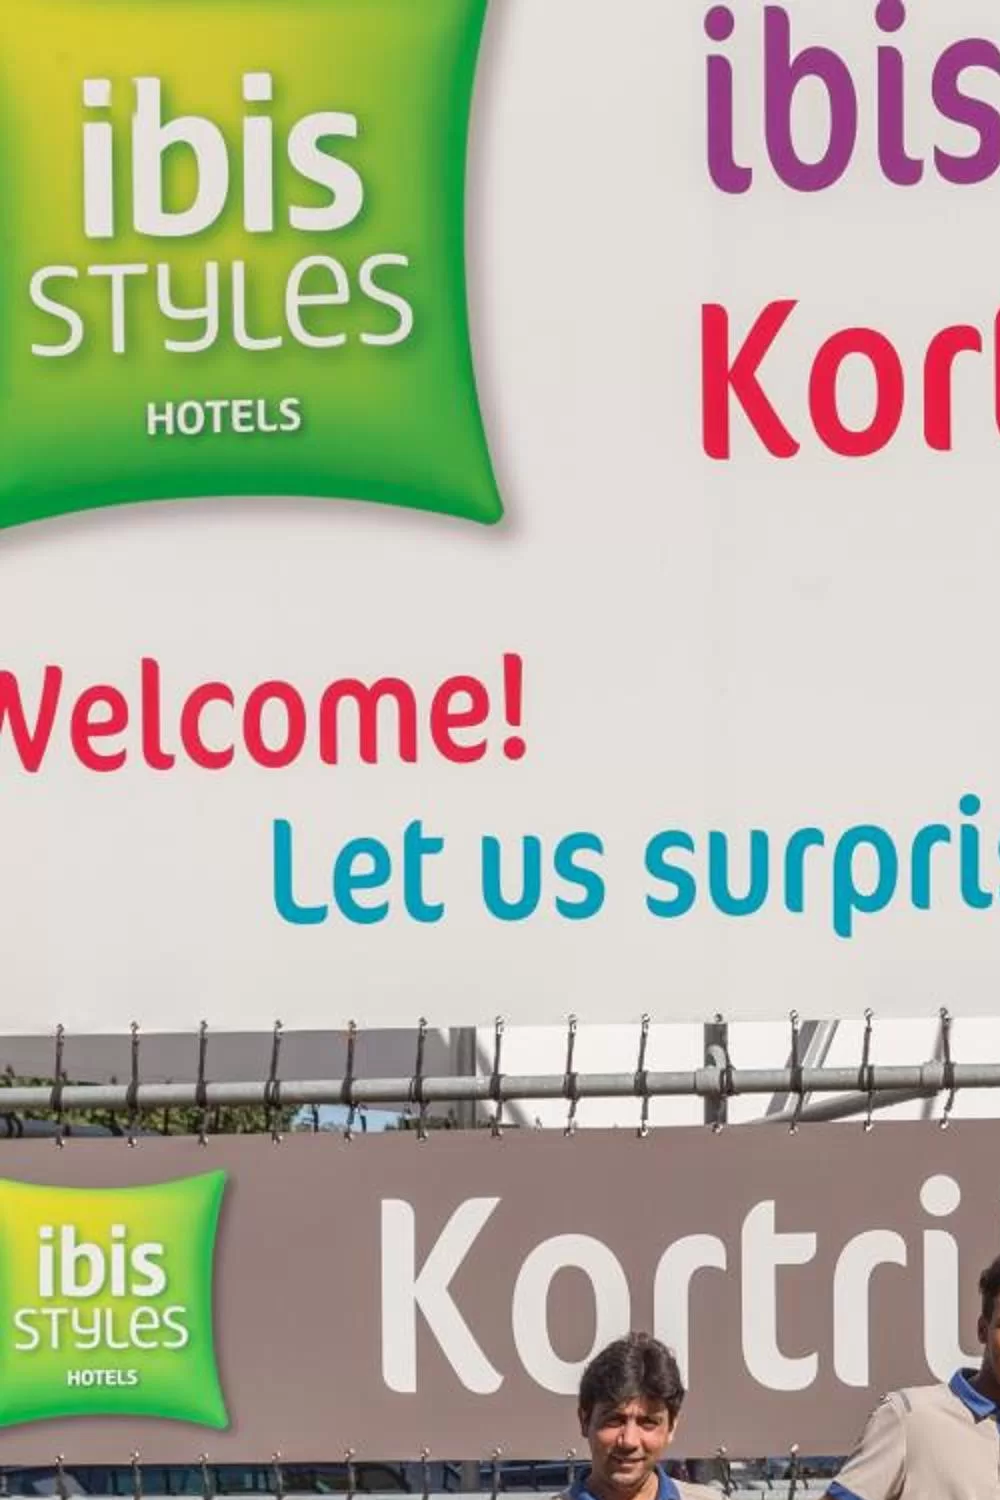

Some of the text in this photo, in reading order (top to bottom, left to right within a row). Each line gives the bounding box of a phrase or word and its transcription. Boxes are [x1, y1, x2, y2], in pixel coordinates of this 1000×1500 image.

[82, 71, 365, 238] ibis
[146, 398, 302, 436] HOTELS
[272, 818, 446, 926] Let
[480, 831, 607, 922] us
[38, 1223, 168, 1299] ibis
[66, 1368, 139, 1387] HOTELS
